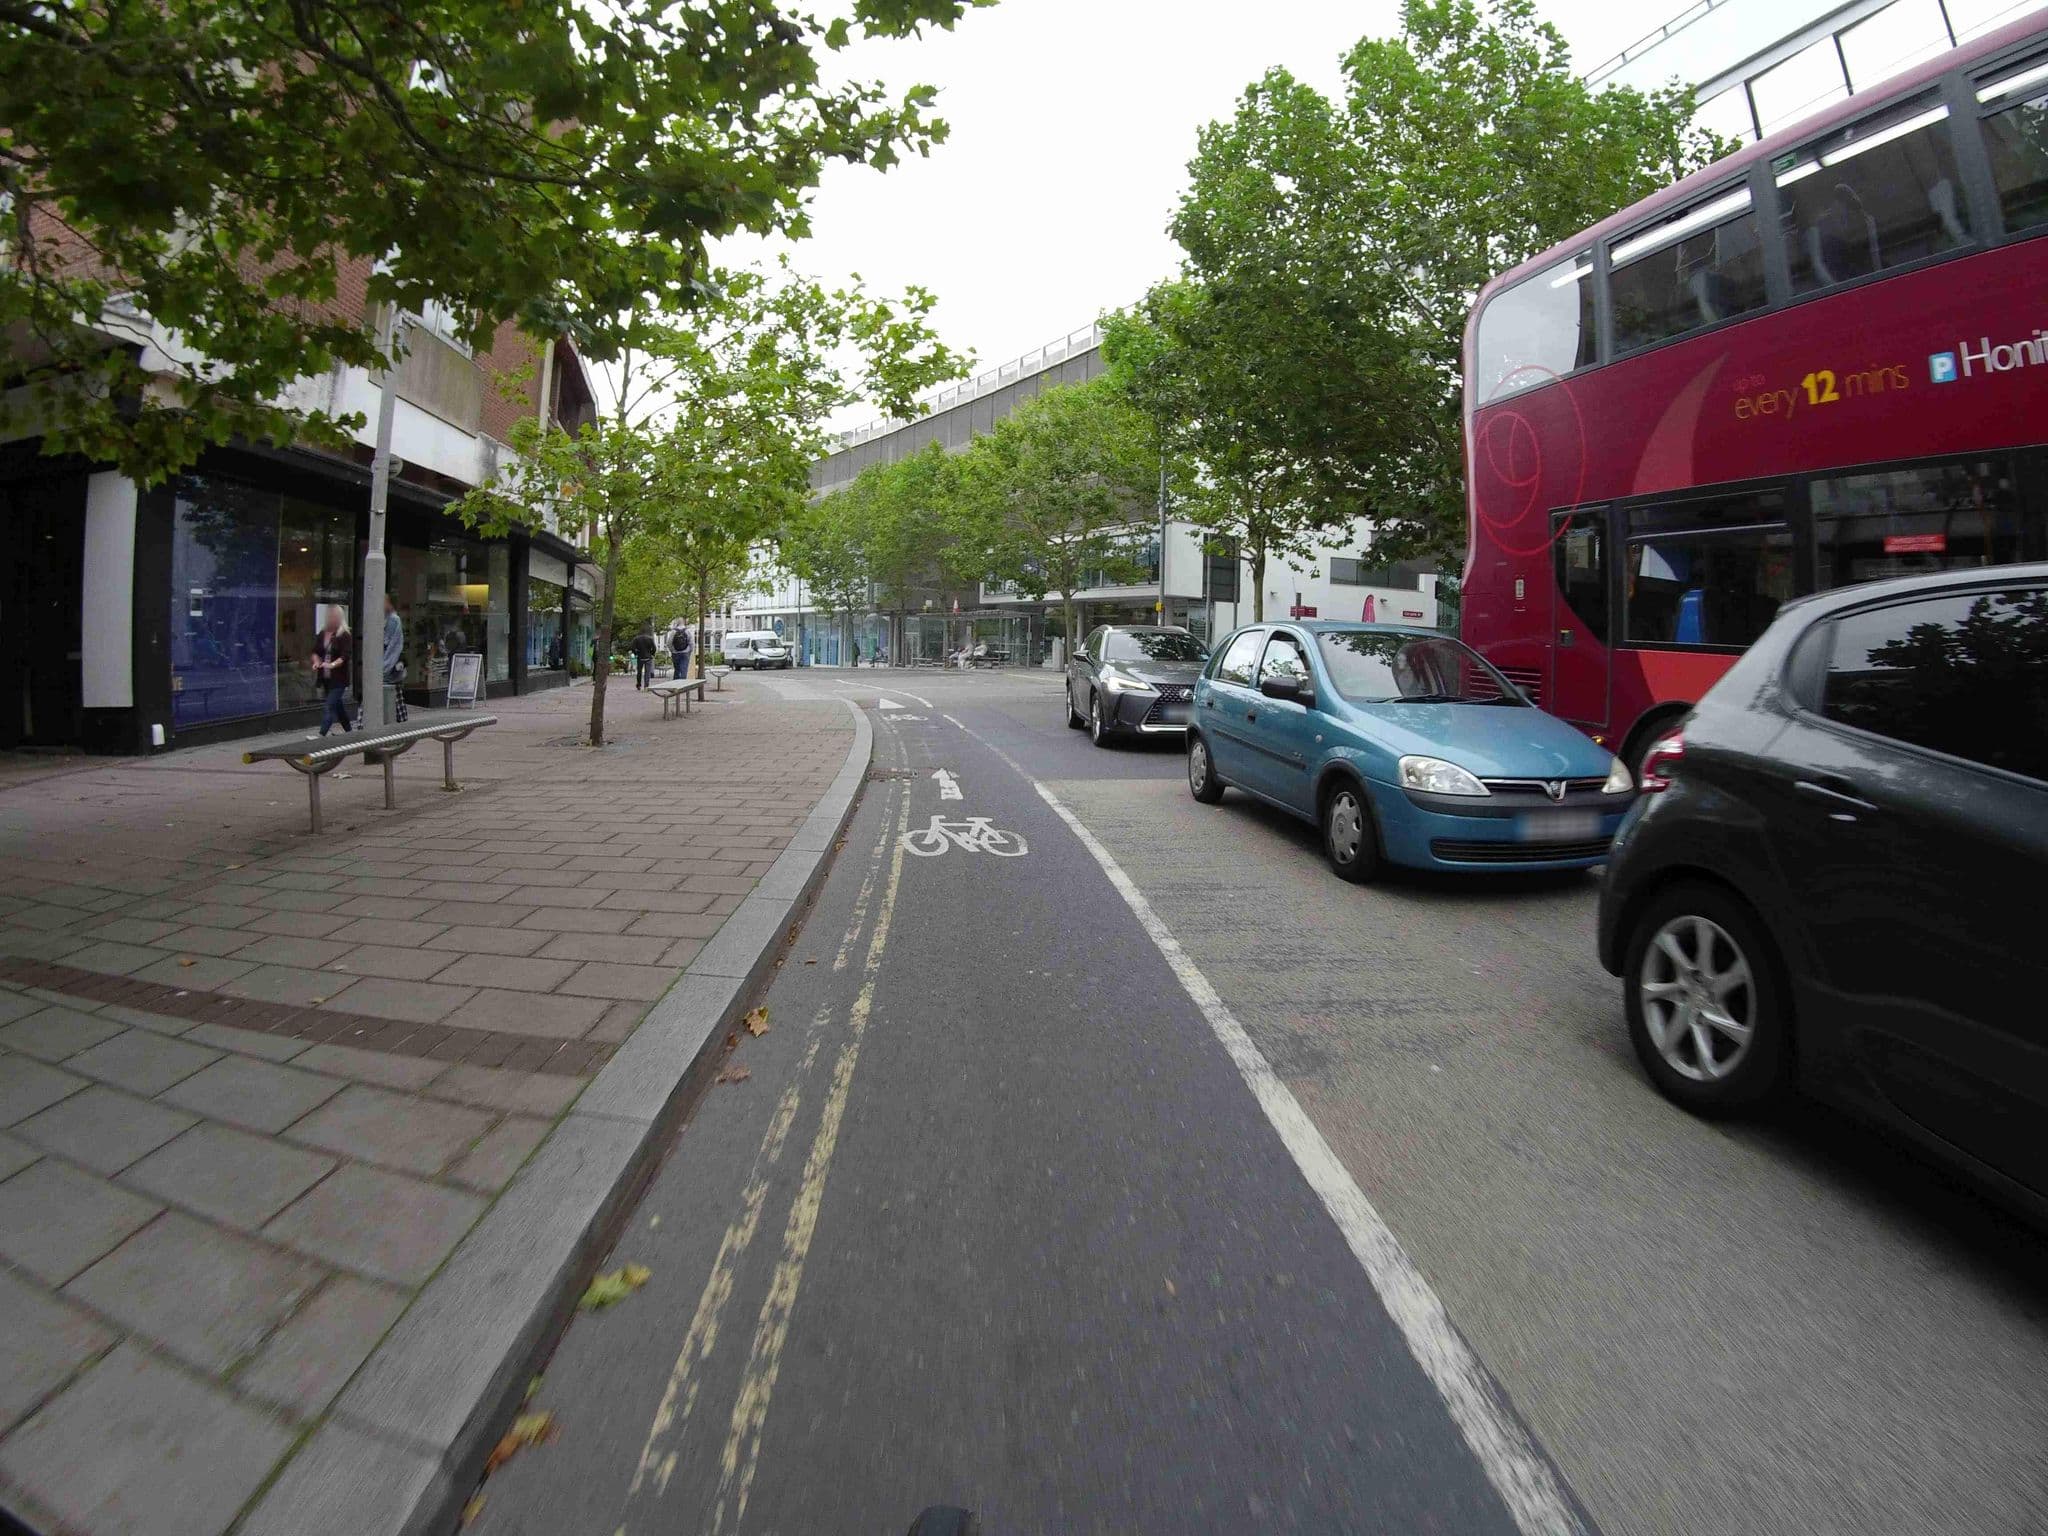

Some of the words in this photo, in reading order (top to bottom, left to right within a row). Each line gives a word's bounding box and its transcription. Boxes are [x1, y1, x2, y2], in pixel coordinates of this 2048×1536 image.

[1932, 356, 1954, 381] P
[1735, 387, 1799, 420] every
[1800, 369, 1841, 405] 12
[1845, 363, 1910, 398] mins
